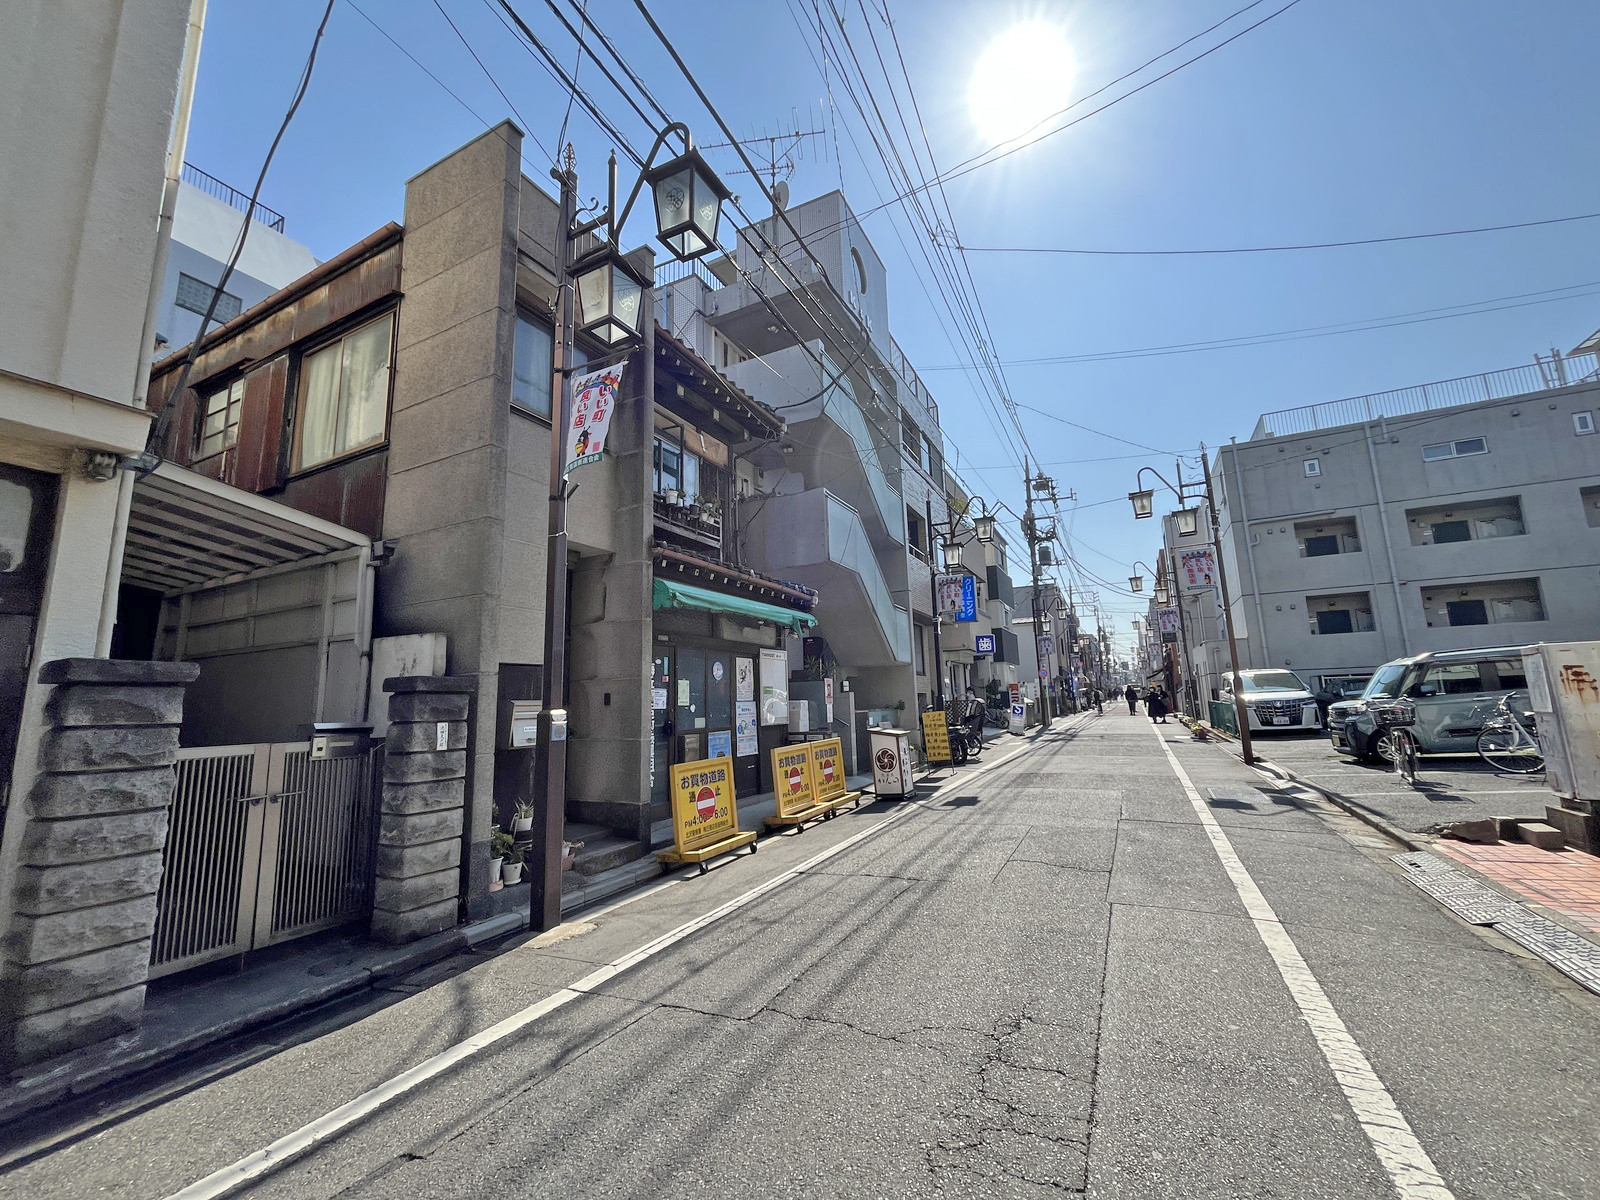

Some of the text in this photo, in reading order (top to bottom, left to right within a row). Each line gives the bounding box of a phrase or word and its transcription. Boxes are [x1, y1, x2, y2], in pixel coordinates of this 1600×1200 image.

[592, 385, 612, 422] いい町
[964, 578, 974, 616] クリーニング
[978, 637, 992, 651] 歯
[779, 753, 807, 768] お買物道路
[815, 747, 838, 760] お買物道路
[681, 769, 726, 789] お買物道路
